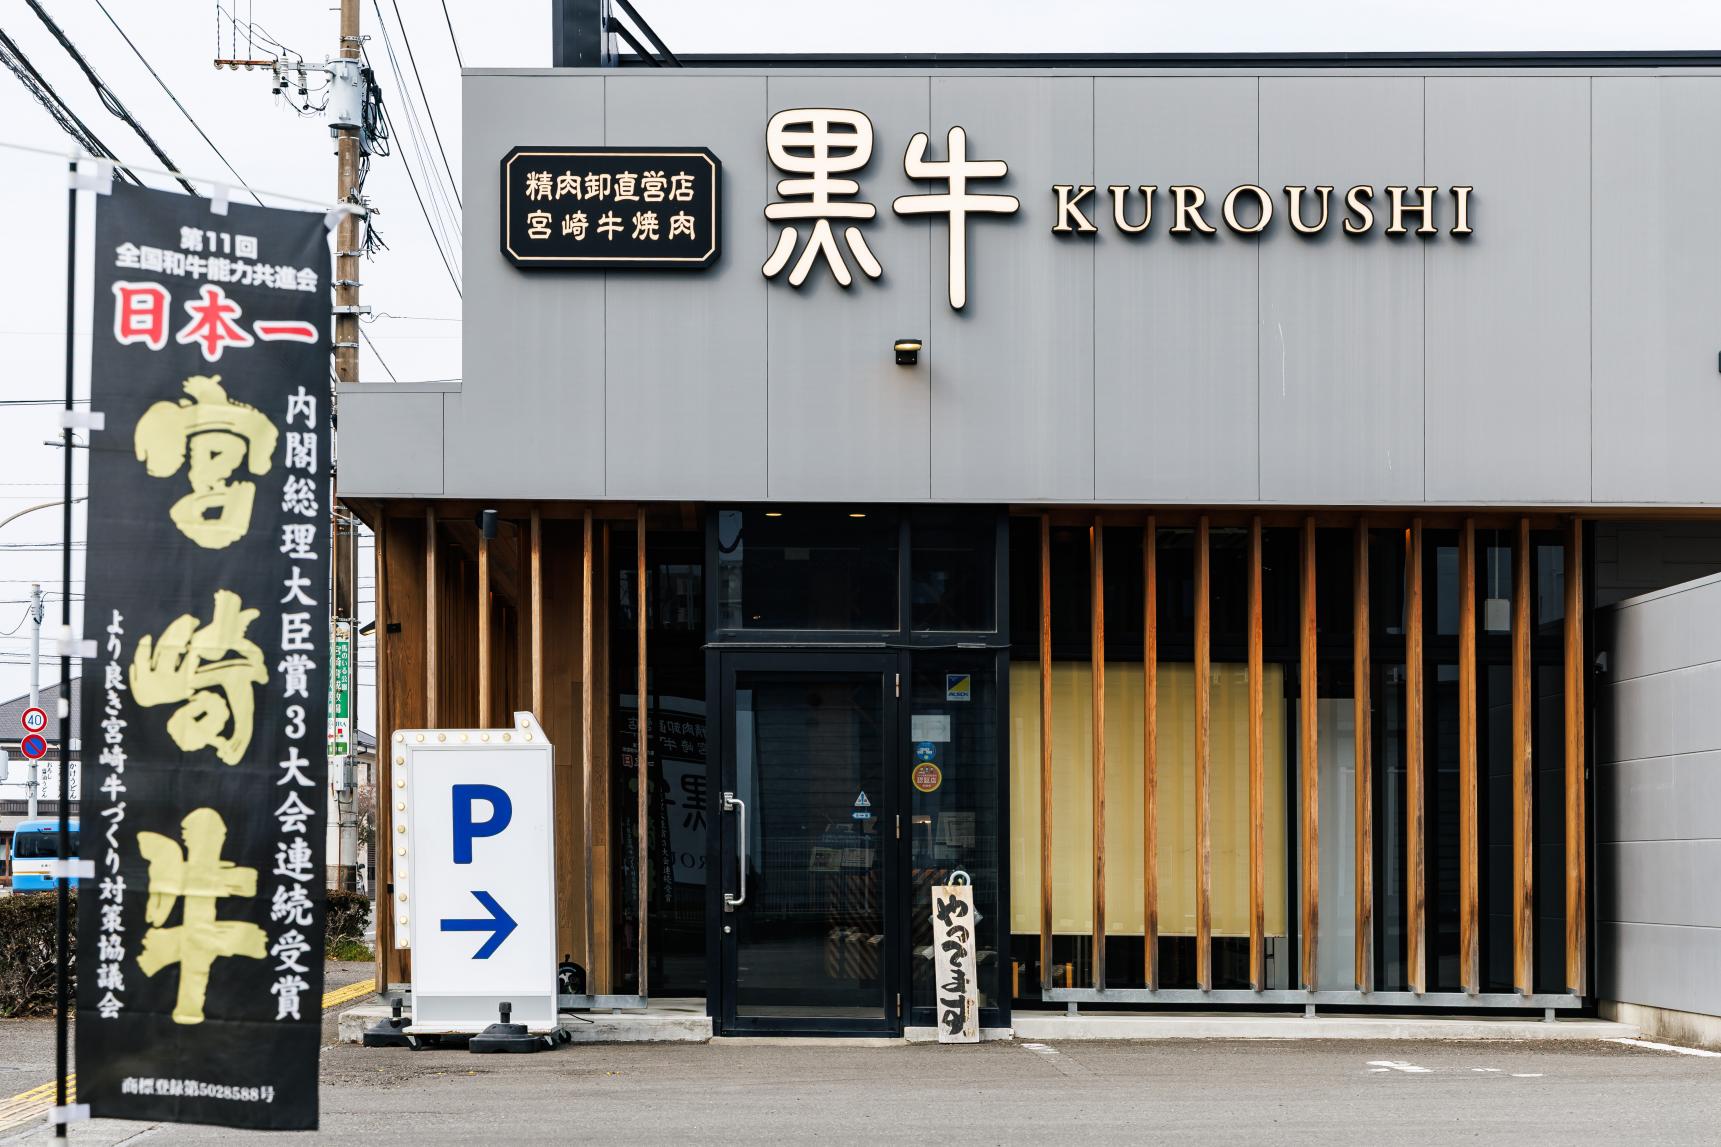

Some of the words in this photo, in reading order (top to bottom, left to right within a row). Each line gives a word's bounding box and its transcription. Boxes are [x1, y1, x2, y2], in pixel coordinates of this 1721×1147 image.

[526, 170, 695, 202] 精肉卸直営店
[761, 107, 1020, 312] 黒牛
[1052, 184, 1475, 235] KUROUSHI
[180, 226, 259, 260] 第11回
[526, 210, 695, 241] 宮崎牛焼肉
[115, 242, 319, 292] 全国和牛能力共進会
[112, 281, 319, 361] 日本一
[27, 714, 42, 727] 40
[129, 375, 279, 1025] 宮崎牛
[452, 784, 513, 864] P
